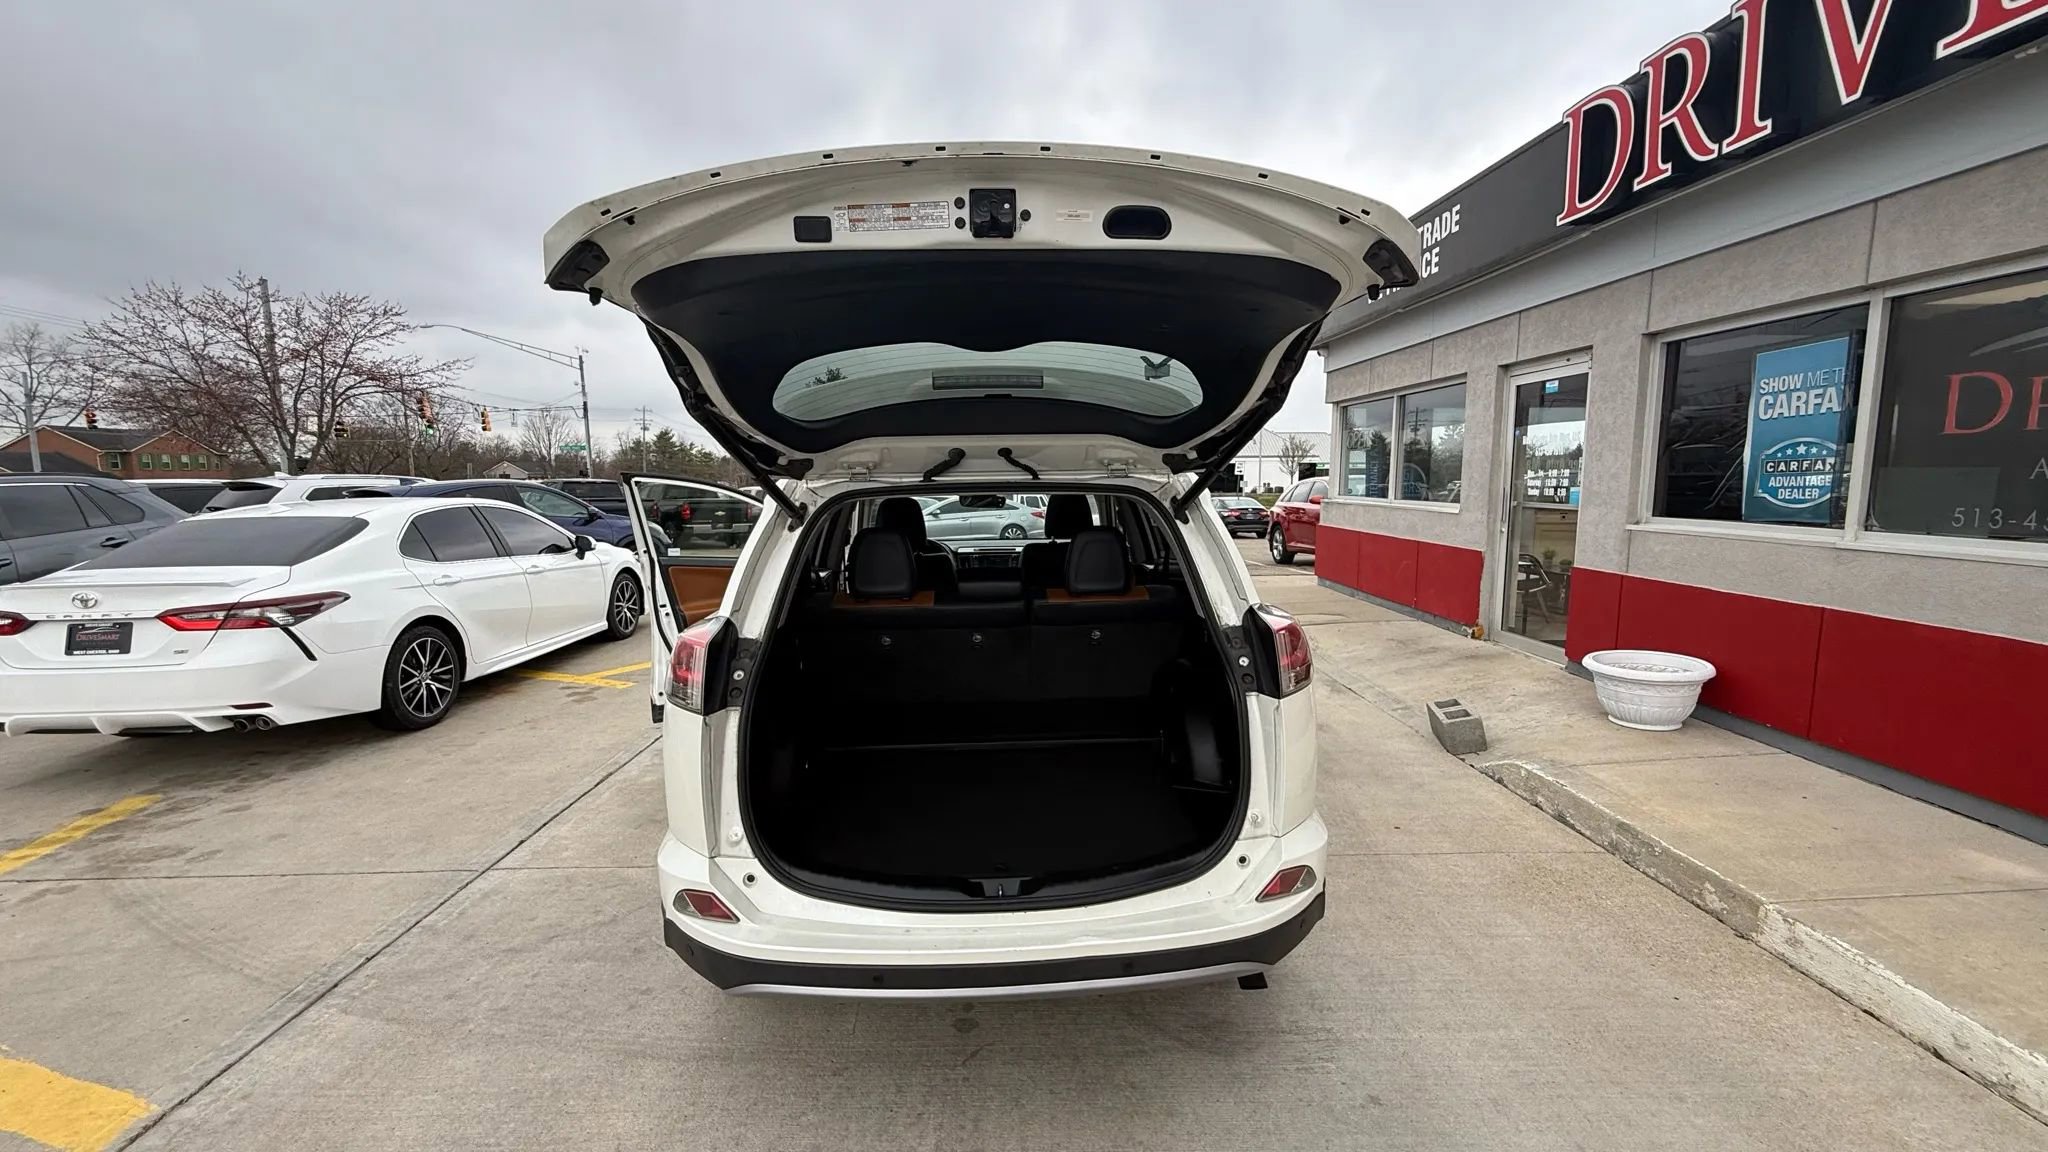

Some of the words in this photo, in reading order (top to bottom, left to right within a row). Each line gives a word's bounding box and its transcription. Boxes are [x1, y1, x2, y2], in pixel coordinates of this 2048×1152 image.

[1556, 0, 2048, 226] DRIV
[1760, 373, 1805, 394] SHOW
[1807, 369, 1830, 387] ME
[1758, 386, 1845, 420] CARFA
[1768, 474, 1834, 488] ADVANTAGE
[1777, 488, 1820, 500] DEALER
